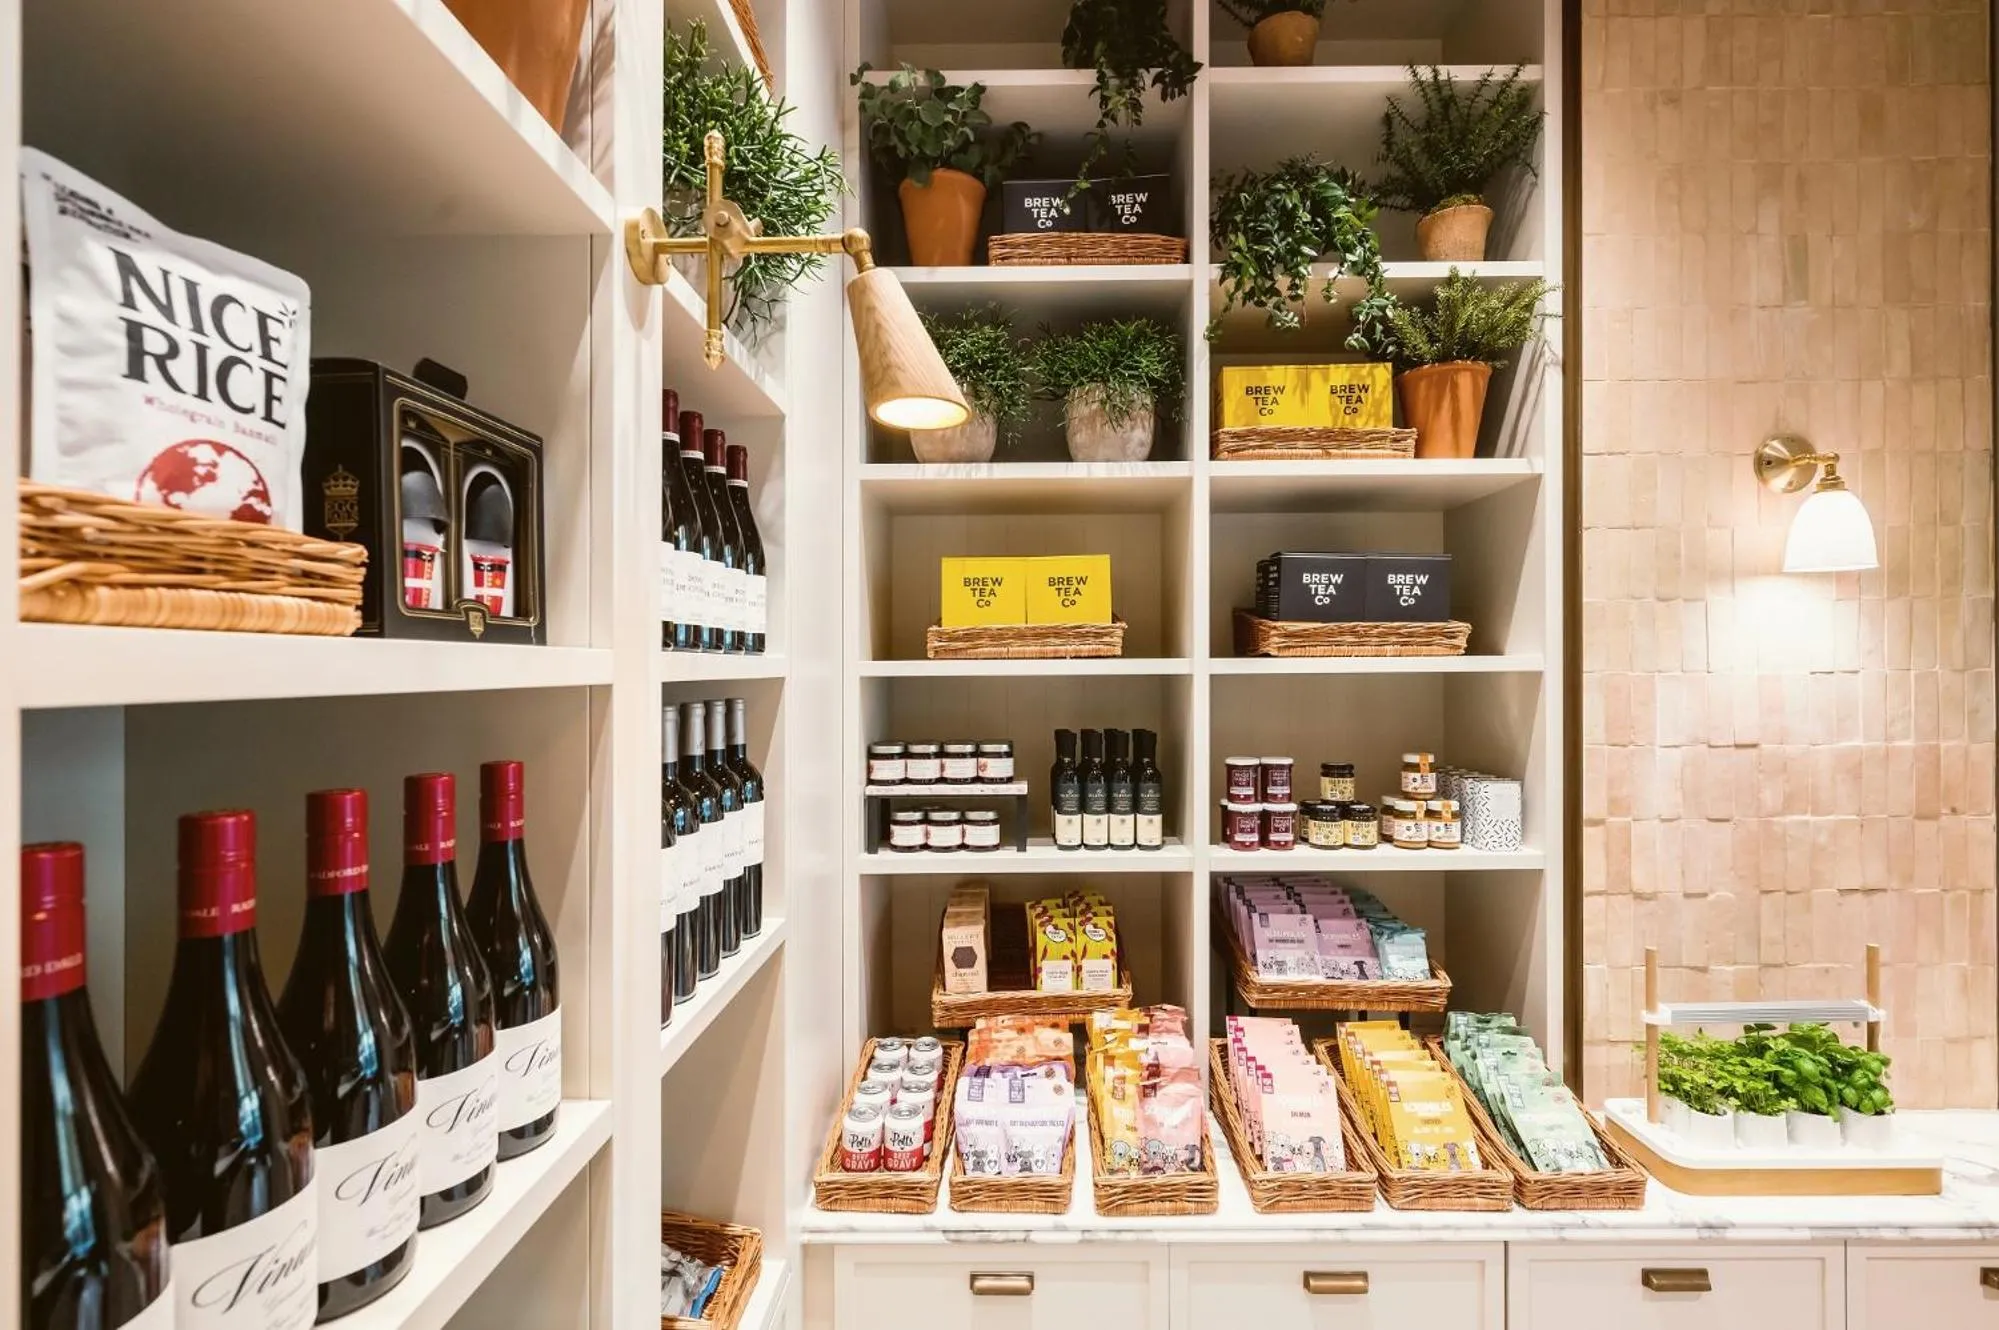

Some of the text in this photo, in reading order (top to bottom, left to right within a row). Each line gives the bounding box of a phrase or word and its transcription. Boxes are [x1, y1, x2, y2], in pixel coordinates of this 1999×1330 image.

[1025, 198, 1064, 208] BREW
[1031, 208, 1058, 218] TEA
[1115, 204, 1142, 214] TEA
[1037, 219, 1053, 229] Co
[1121, 215, 1137, 225] Co
[108, 246, 288, 370] NICE
[119, 316, 287, 429] RICE
[1245, 385, 1286, 396] BREW
[1330, 384, 1370, 394] BREW
[1253, 396, 1279, 406] TEA
[1337, 395, 1364, 405] TEA
[1259, 407, 1274, 416] Co
[1343, 406, 1358, 415] Co
[963, 577, 1003, 587] BREW
[1048, 576, 1088, 586] BREW
[1302, 573, 1344, 584] BREW
[1387, 574, 1429, 585] BREW
[970, 587, 997, 597] TEA
[1055, 587, 1082, 597] TEA
[1309, 584, 1336, 595] TEA
[1394, 585, 1421, 596] TEA
[976, 599, 991, 608] Co
[1061, 598, 1076, 608] Co
[1315, 596, 1331, 605] Co
[1400, 596, 1415, 606] Co
[887, 1157, 917, 1169] GRAVY
